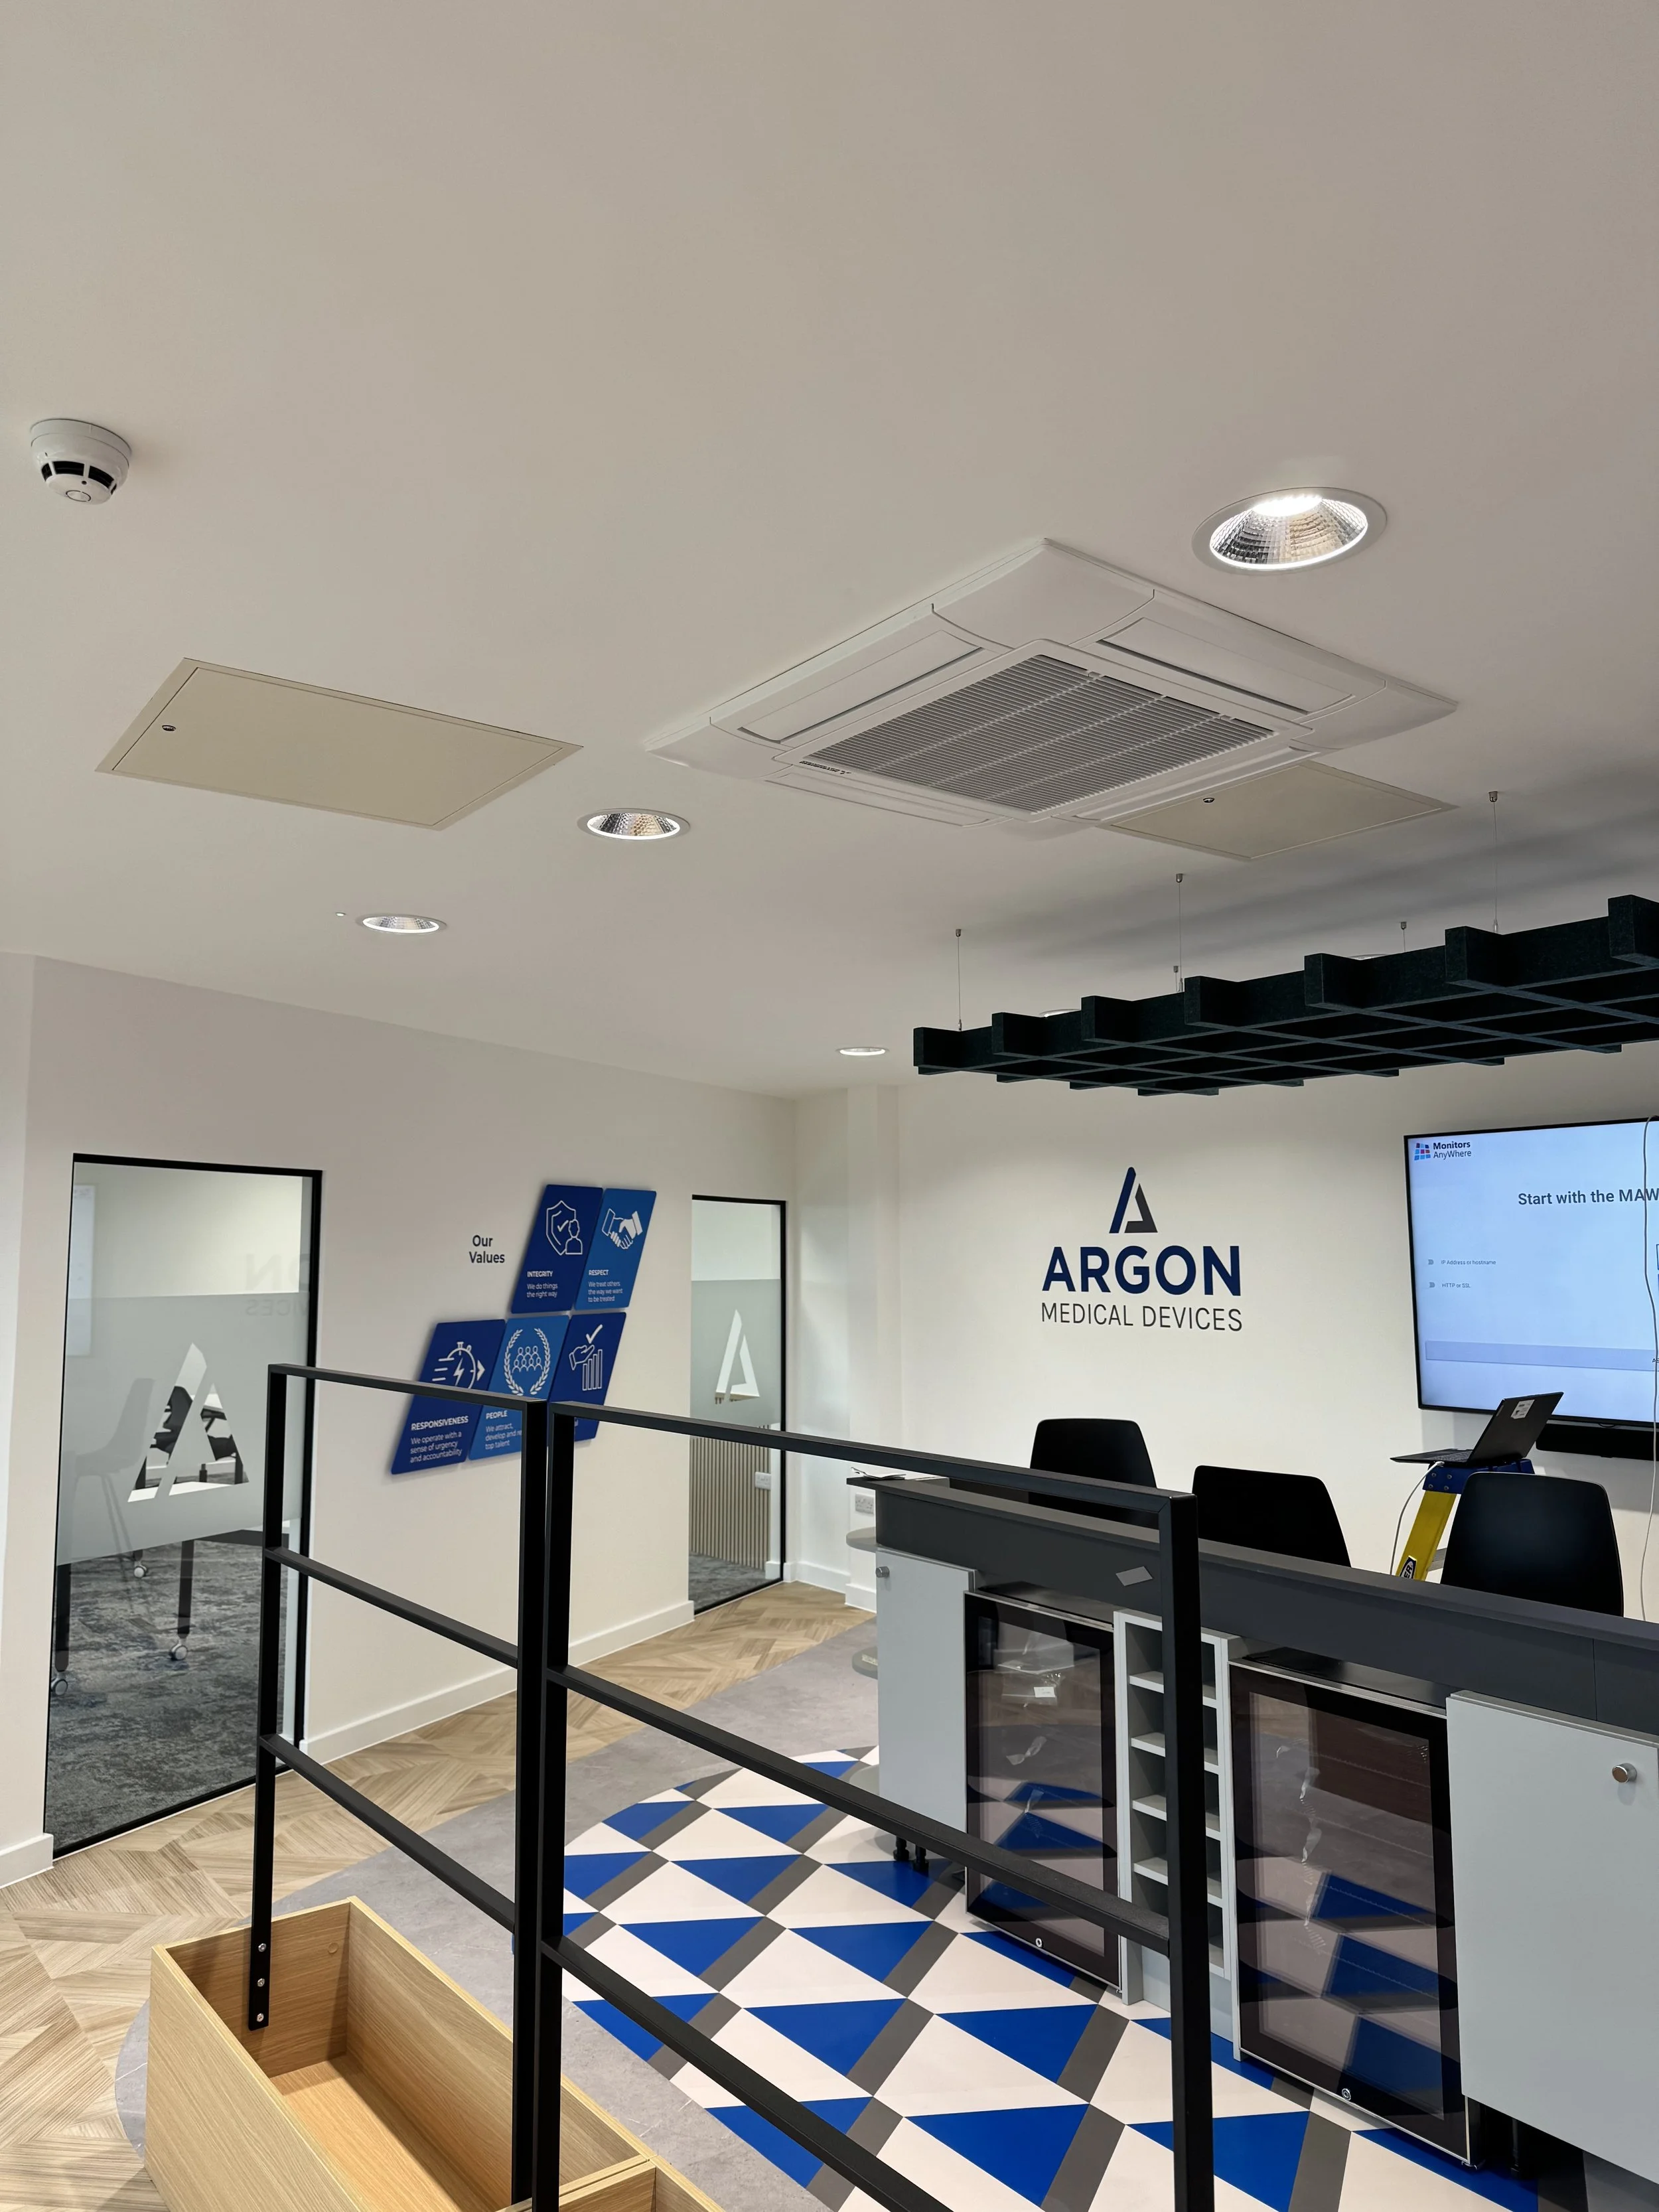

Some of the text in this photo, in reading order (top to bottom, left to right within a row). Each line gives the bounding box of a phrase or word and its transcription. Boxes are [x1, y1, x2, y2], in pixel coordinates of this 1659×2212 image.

[1433, 1141, 1471, 1149] Monitors
[1433, 1150, 1471, 1160] AnyWhere
[1518, 1188, 1659, 1205] Start with the MAW
[472, 1234, 493, 1247] Our
[469, 1250, 505, 1264] Values
[1042, 1245, 1241, 1296] ARGON
[1041, 1303, 1242, 1332] MEDICAL DEVICES
[486, 1410, 508, 1420] PEOPLE
[411, 1416, 469, 1431] RESPONSIVENESS
[421, 1434, 443, 1443] operate
[485, 1432, 506, 1441] develop
[435, 1441, 459, 1450] urgency
[494, 1439, 510, 1448] talent
[410, 1448, 462, 1463] and accountability
